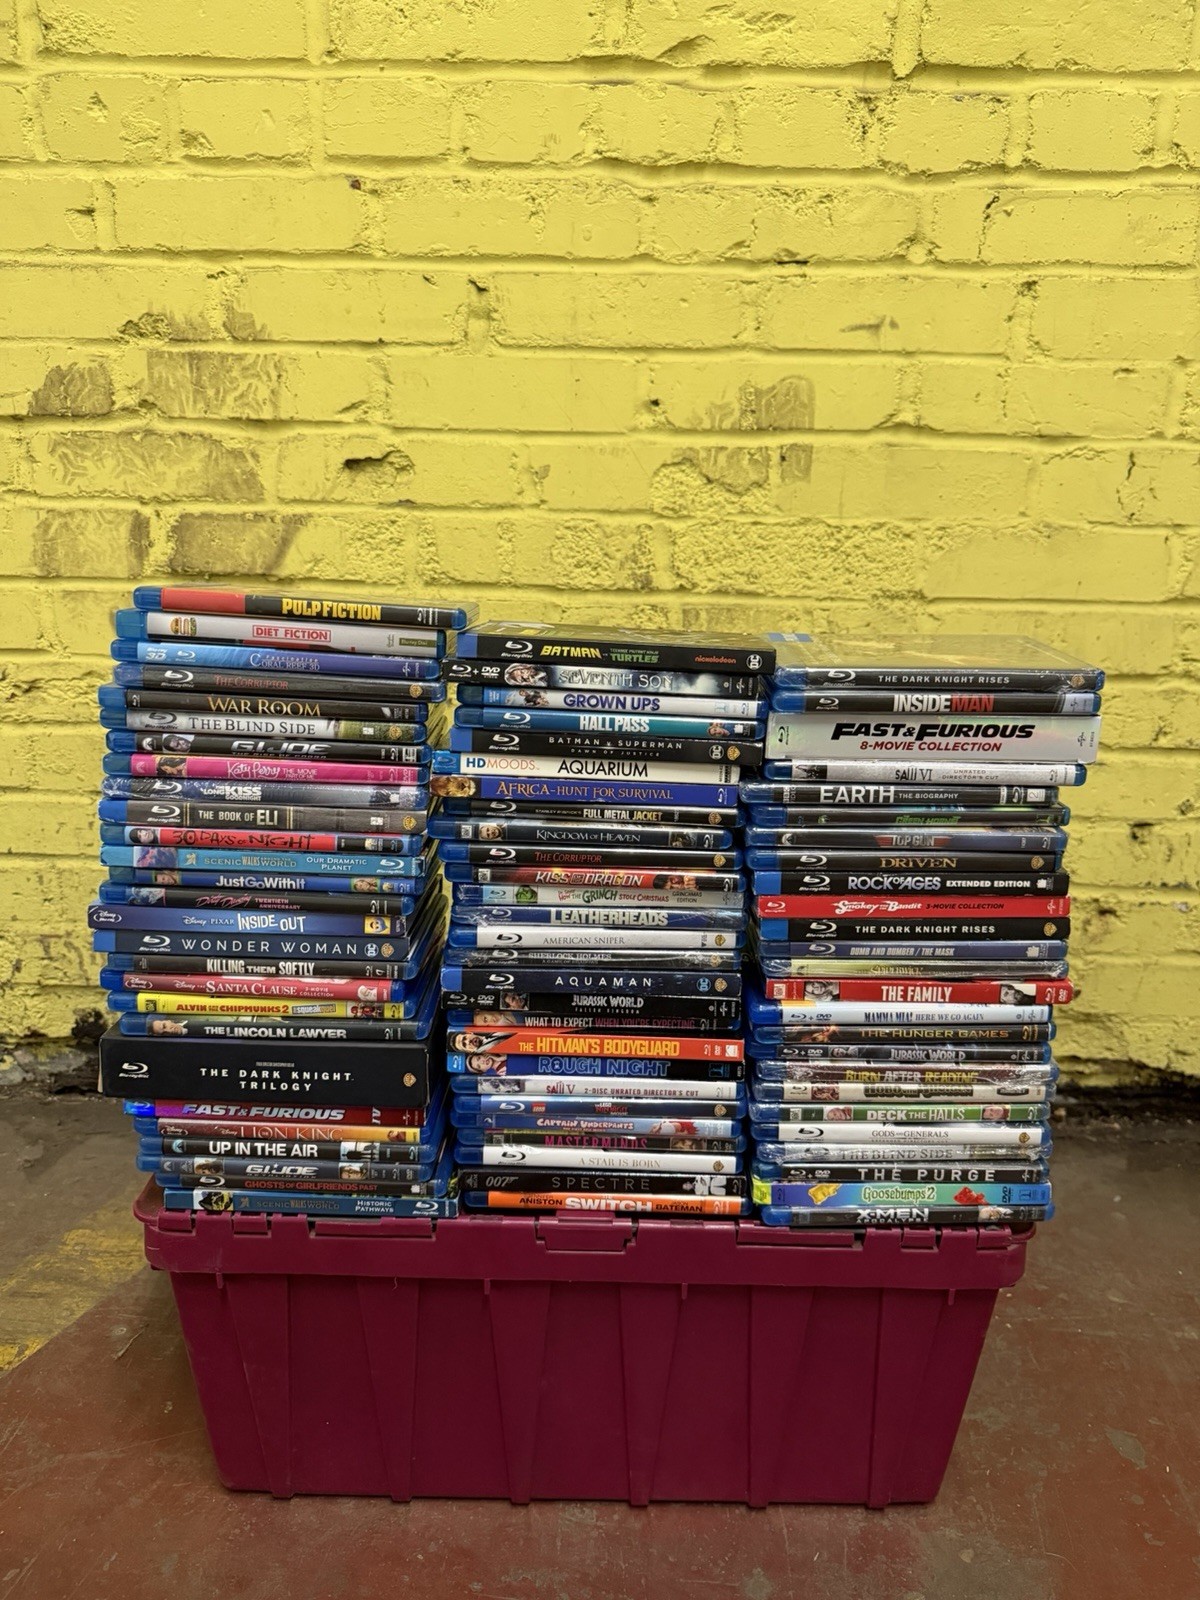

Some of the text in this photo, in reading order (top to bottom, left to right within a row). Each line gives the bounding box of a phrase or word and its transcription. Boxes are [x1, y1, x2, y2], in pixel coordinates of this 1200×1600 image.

[256, 627, 328, 640] DIET FICTION
[540, 645, 602, 659] BATMAN
[611, 654, 659, 664] TURTLES
[695, 655, 736, 664] nickelodeon
[639, 674, 673, 688] SON
[207, 697, 320, 716] WAR ROOM
[564, 694, 660, 711] GROWN UPS
[189, 718, 315, 734] THE BLIND SIDE
[580, 715, 649, 732] HALL PASS
[549, 737, 682, 749] BATMAN SUPERMAN
[860, 741, 1002, 752] 8-MOVIE COLLECTION
[558, 759, 648, 778] AQUARIUM
[919, 769, 933, 781] VI
[226, 786, 262, 796] KISS
[593, 787, 673, 801] FOR SURVIVAL
[820, 786, 894, 804] EARTH
[198, 810, 278, 825] THE BOOK OF ELI
[583, 809, 663, 821] FULL METAL JACKET
[200, 831, 236, 844] DAYS
[536, 830, 640, 842] KINGDOM HEAVEN
[912, 836, 934, 847] GUN
[327, 857, 367, 865] DRAMATIC
[535, 852, 602, 863] THE CORRUPTOR
[880, 858, 958, 868] DRIVEN
[260, 860, 296, 868] WORLD
[536, 871, 571, 884] KISS
[584, 873, 643, 886] DRAGON
[582, 889, 618, 903] GRINCH
[831, 900, 879, 915] Smokey
[881, 900, 922, 911] Bandit
[182, 915, 207, 926] Disney
[238, 913, 278, 930] INSIDE
[280, 916, 306, 932] OUT
[551, 910, 668, 926] LEATHERHEADS
[182, 938, 357, 954] WONDER WOMAN
[207, 959, 314, 976] KILLING THEM SOFTLY
[206, 980, 297, 995] SANTA CLAUSE
[555, 977, 652, 986] AQUAMAN
[882, 986, 952, 1002] THE FAMILY
[572, 995, 644, 1008] JURASSIC WORLD
[219, 1005, 280, 1013] CHIPMUNKS
[282, 1006, 289, 1014] 2
[525, 1016, 593, 1027] WHAT TO EXPECT
[864, 1012, 894, 1022] MAMMA
[895, 1012, 913, 1022] MIA!
[226, 1027, 286, 1038] LINCOLN
[290, 1028, 346, 1038] LAWYER
[860, 1029, 1009, 1038] THE HUNGER GAMES
[519, 1037, 680, 1056] THE HITMAN'S BODYGUARD
[890, 1050, 966, 1060] JURASSIC WORLD
[538, 1057, 670, 1076] ROUGH NIGHT
[200, 1068, 351, 1080] THE DARK KNIGHT
[240, 1081, 311, 1091] TRILOGY
[867, 1111, 907, 1120] DECK
[929, 1108, 965, 1120] HALLS
[537, 1118, 577, 1127] CAPTAIN
[581, 1120, 634, 1130] UNDERPANTS
[296, 1128, 343, 1140] KING
[209, 1142, 318, 1157] UP IN THE AIR
[589, 1158, 615, 1166] STAR
[633, 1159, 660, 1168] BORN
[858, 1169, 995, 1181] THE PURGE
[296, 1182, 358, 1191] GIRLFRIENDS
[552, 1177, 650, 1190] SPECTRE
[862, 1186, 935, 1203] Goosebumps 2
[565, 1198, 652, 1212] SWITCH
[857, 1209, 928, 1218] X-MEN
